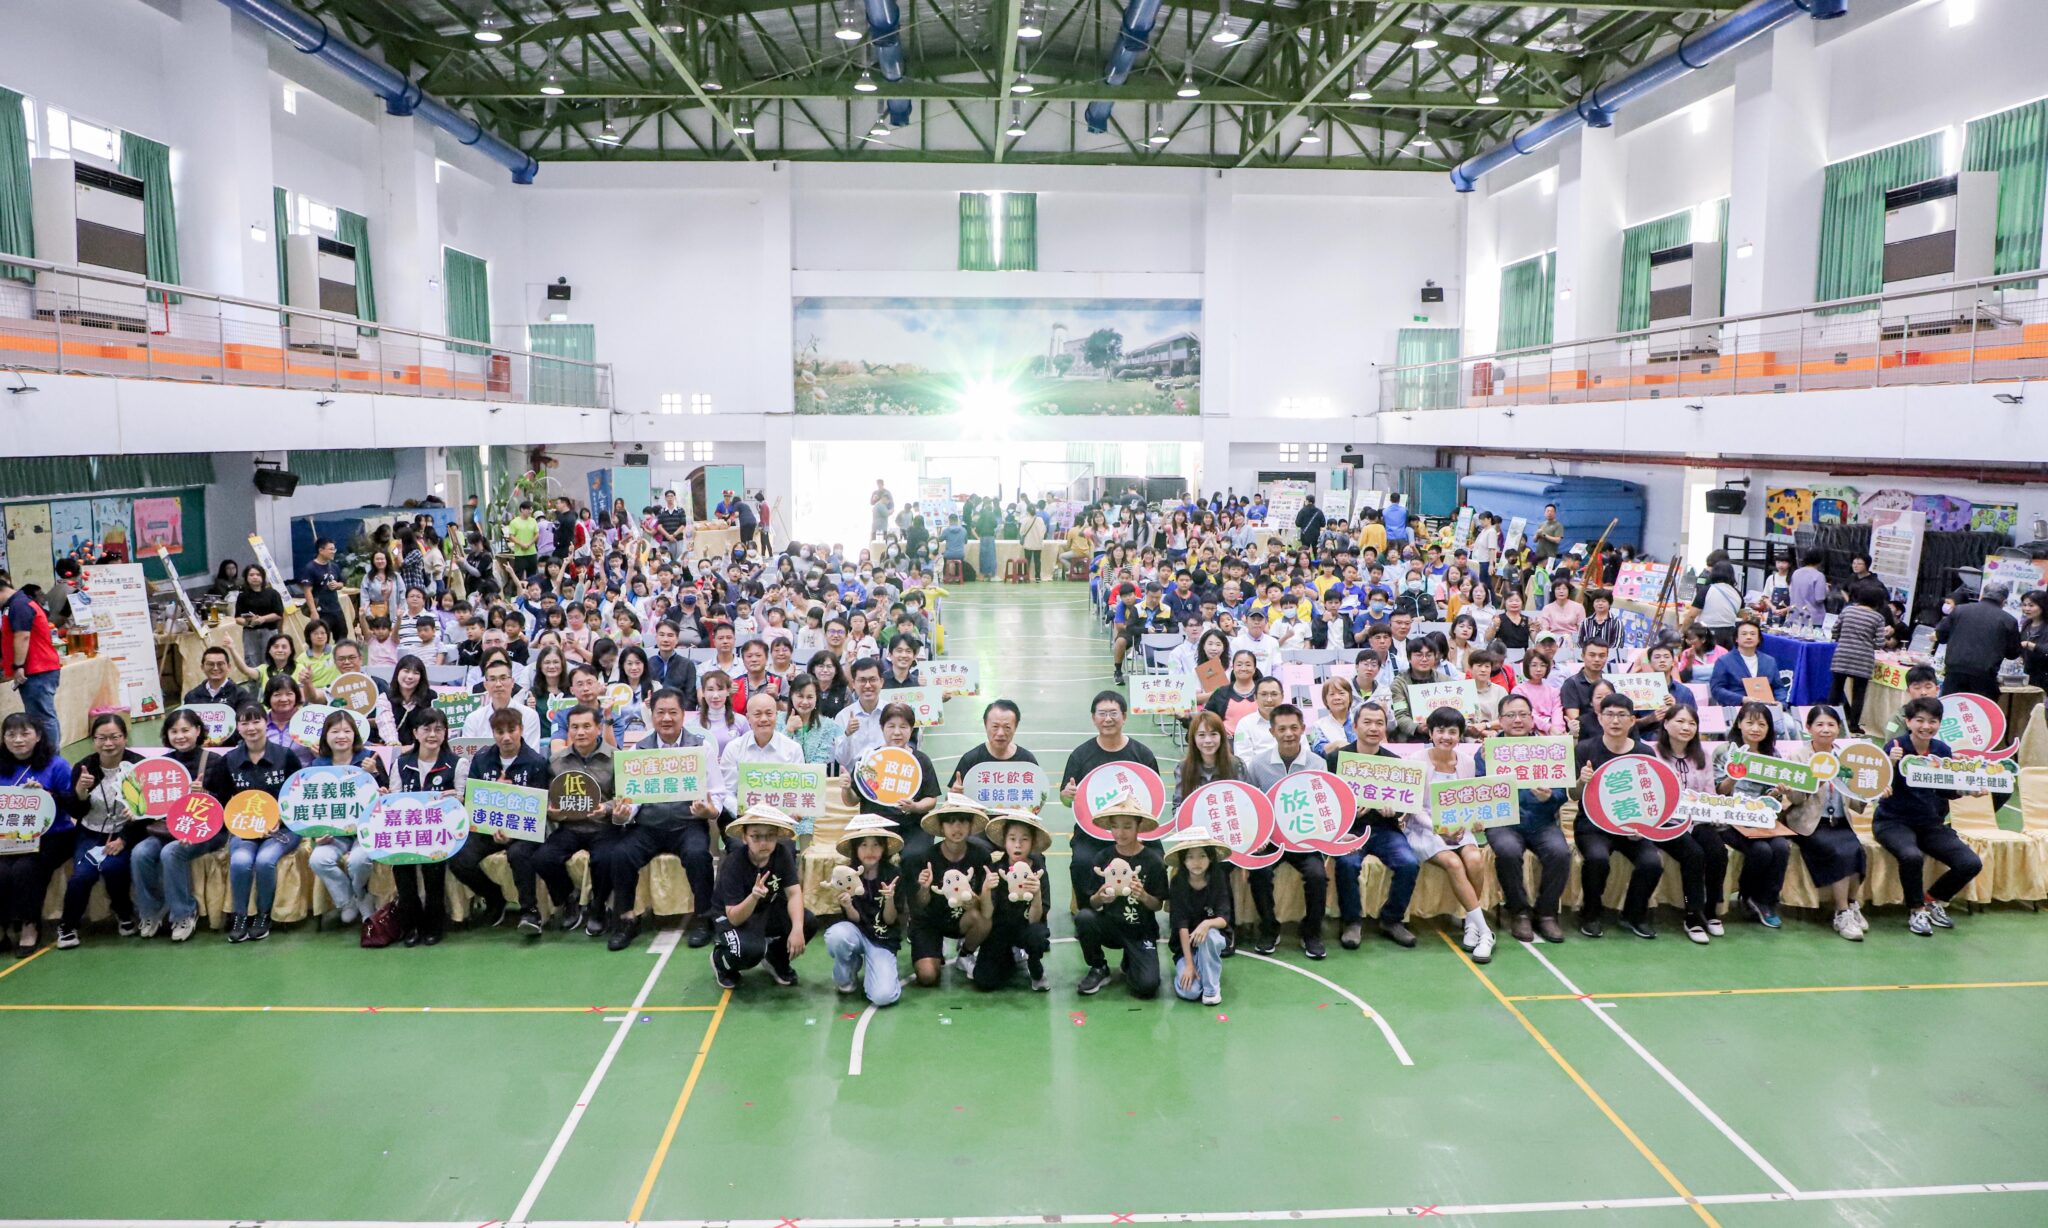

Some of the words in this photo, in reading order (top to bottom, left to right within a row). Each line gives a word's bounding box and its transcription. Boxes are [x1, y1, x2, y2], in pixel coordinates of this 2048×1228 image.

[1494, 743, 1566, 762] 培養均衡
[624, 755, 698, 775] 地產地消
[884, 760, 915, 778] 政府
[1342, 760, 1422, 785] 傳承與創新
[1749, 761, 1807, 784] 國產食材
[147, 770, 182, 785] 學生
[564, 773, 587, 796] 低
[626, 776, 699, 796] 永續農業
[746, 770, 818, 789] 支持認同
[881, 777, 912, 795] 把關
[977, 771, 1035, 785] 深化飲食
[1857, 768, 1879, 789] 讚
[148, 787, 182, 803] 健康
[302, 782, 356, 800] 嘉義縣
[746, 792, 816, 808] 在地農業
[977, 788, 1035, 802] 連結農業
[1439, 783, 1511, 807] 珍惜食物
[1603, 769, 1642, 821] 營養
[186, 797, 214, 822] 吃
[242, 794, 267, 816] 食
[473, 788, 540, 815] 深化飲食
[558, 795, 593, 812] 碳排
[1280, 789, 1316, 834] 放心
[293, 803, 365, 822] 鹿草國小
[384, 807, 443, 827] 嘉義縣
[472, 808, 537, 833] 連結農業
[1222, 791, 1242, 846] 嘉義優鮮
[1441, 802, 1511, 825] 減少浪費
[174, 815, 213, 838] 當令
[231, 813, 266, 833] 在地
[373, 828, 453, 849] 鹿草國小
